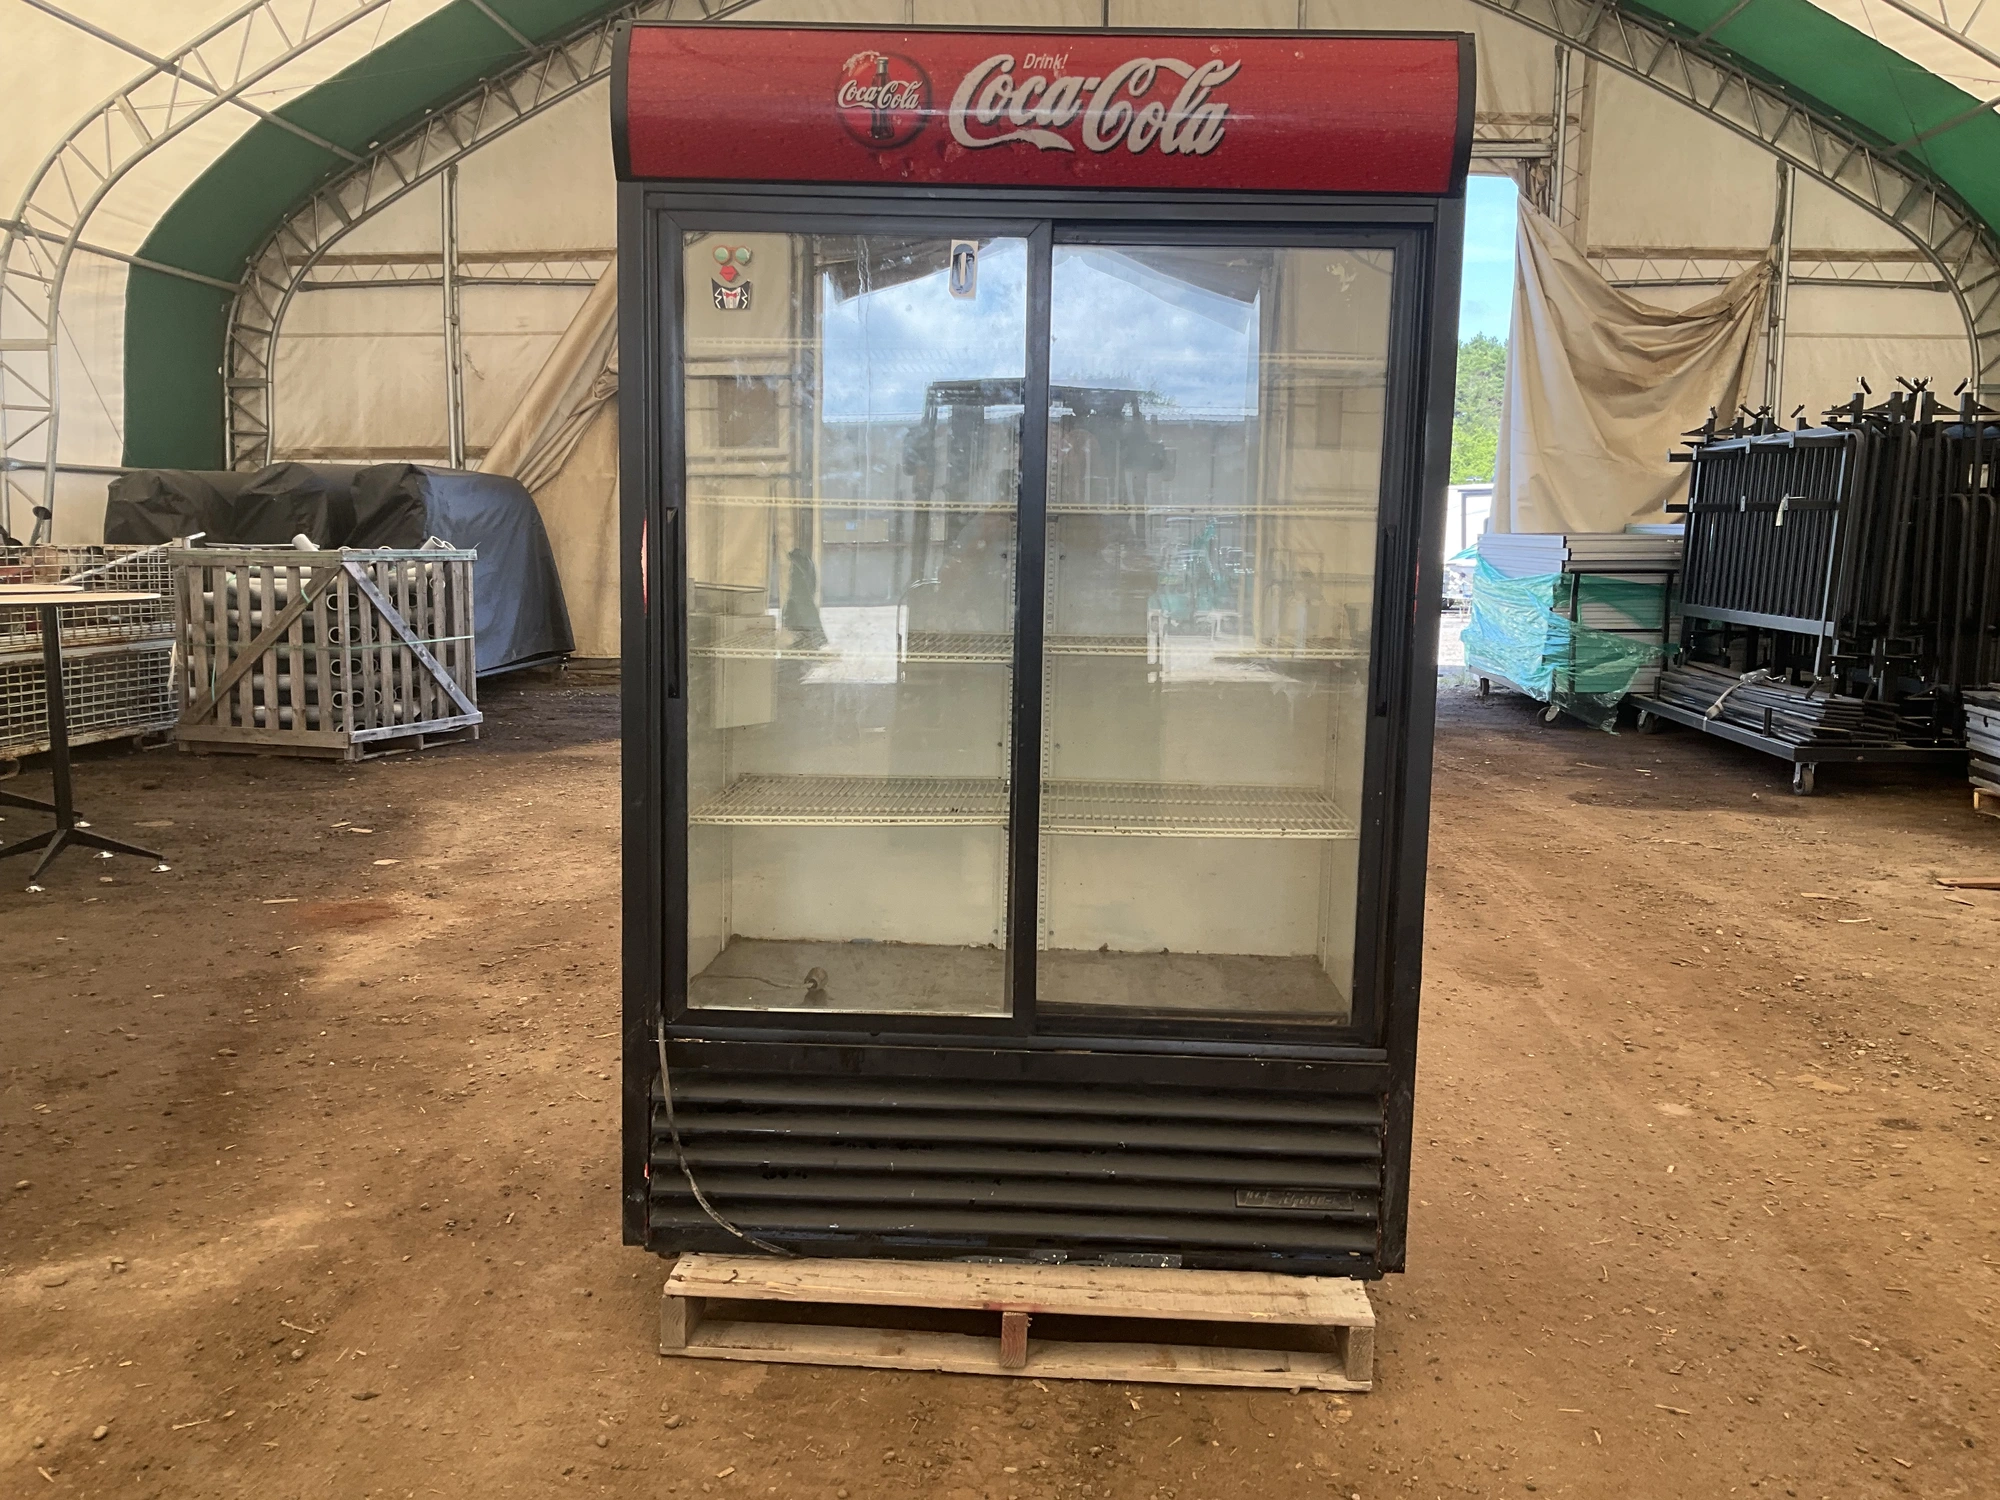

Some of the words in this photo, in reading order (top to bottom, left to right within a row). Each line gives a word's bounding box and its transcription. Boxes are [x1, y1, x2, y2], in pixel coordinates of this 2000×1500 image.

[1023, 52, 1068, 70] Drink!
[838, 80, 923, 109] Coca-Cola
[949, 53, 1241, 154] Coca-Cola
